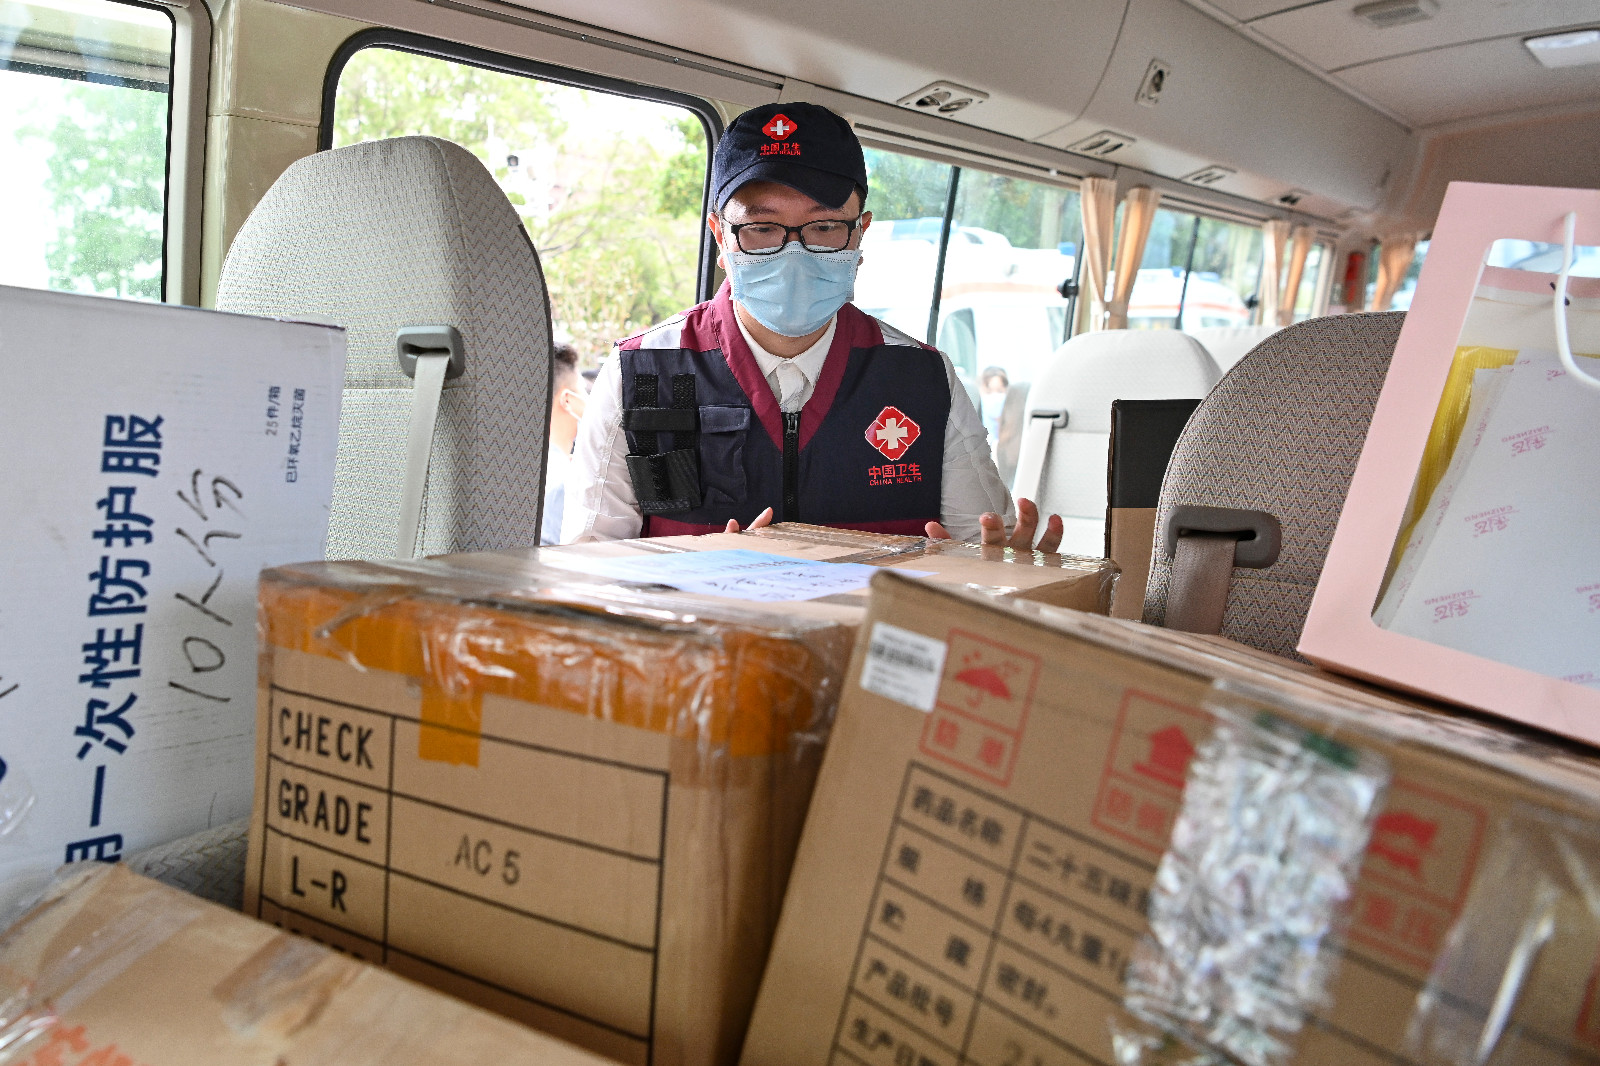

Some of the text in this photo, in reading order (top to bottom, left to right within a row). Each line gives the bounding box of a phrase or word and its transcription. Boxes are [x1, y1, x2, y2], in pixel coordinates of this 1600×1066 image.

[760, 142, 801, 153] 中国卫生
[266, 385, 281, 437] 25件/箱
[286, 388, 306, 484] 已环氧乙烷灭菌
[868, 462, 922, 479] 中国卫生
[869, 475, 923, 486] CHINA HEALTH
[278, 706, 375, 770] CHECK
[279, 778, 373, 845] GRADE
[290, 856, 347, 914] L-R
[454, 834, 521, 886] AC 5
